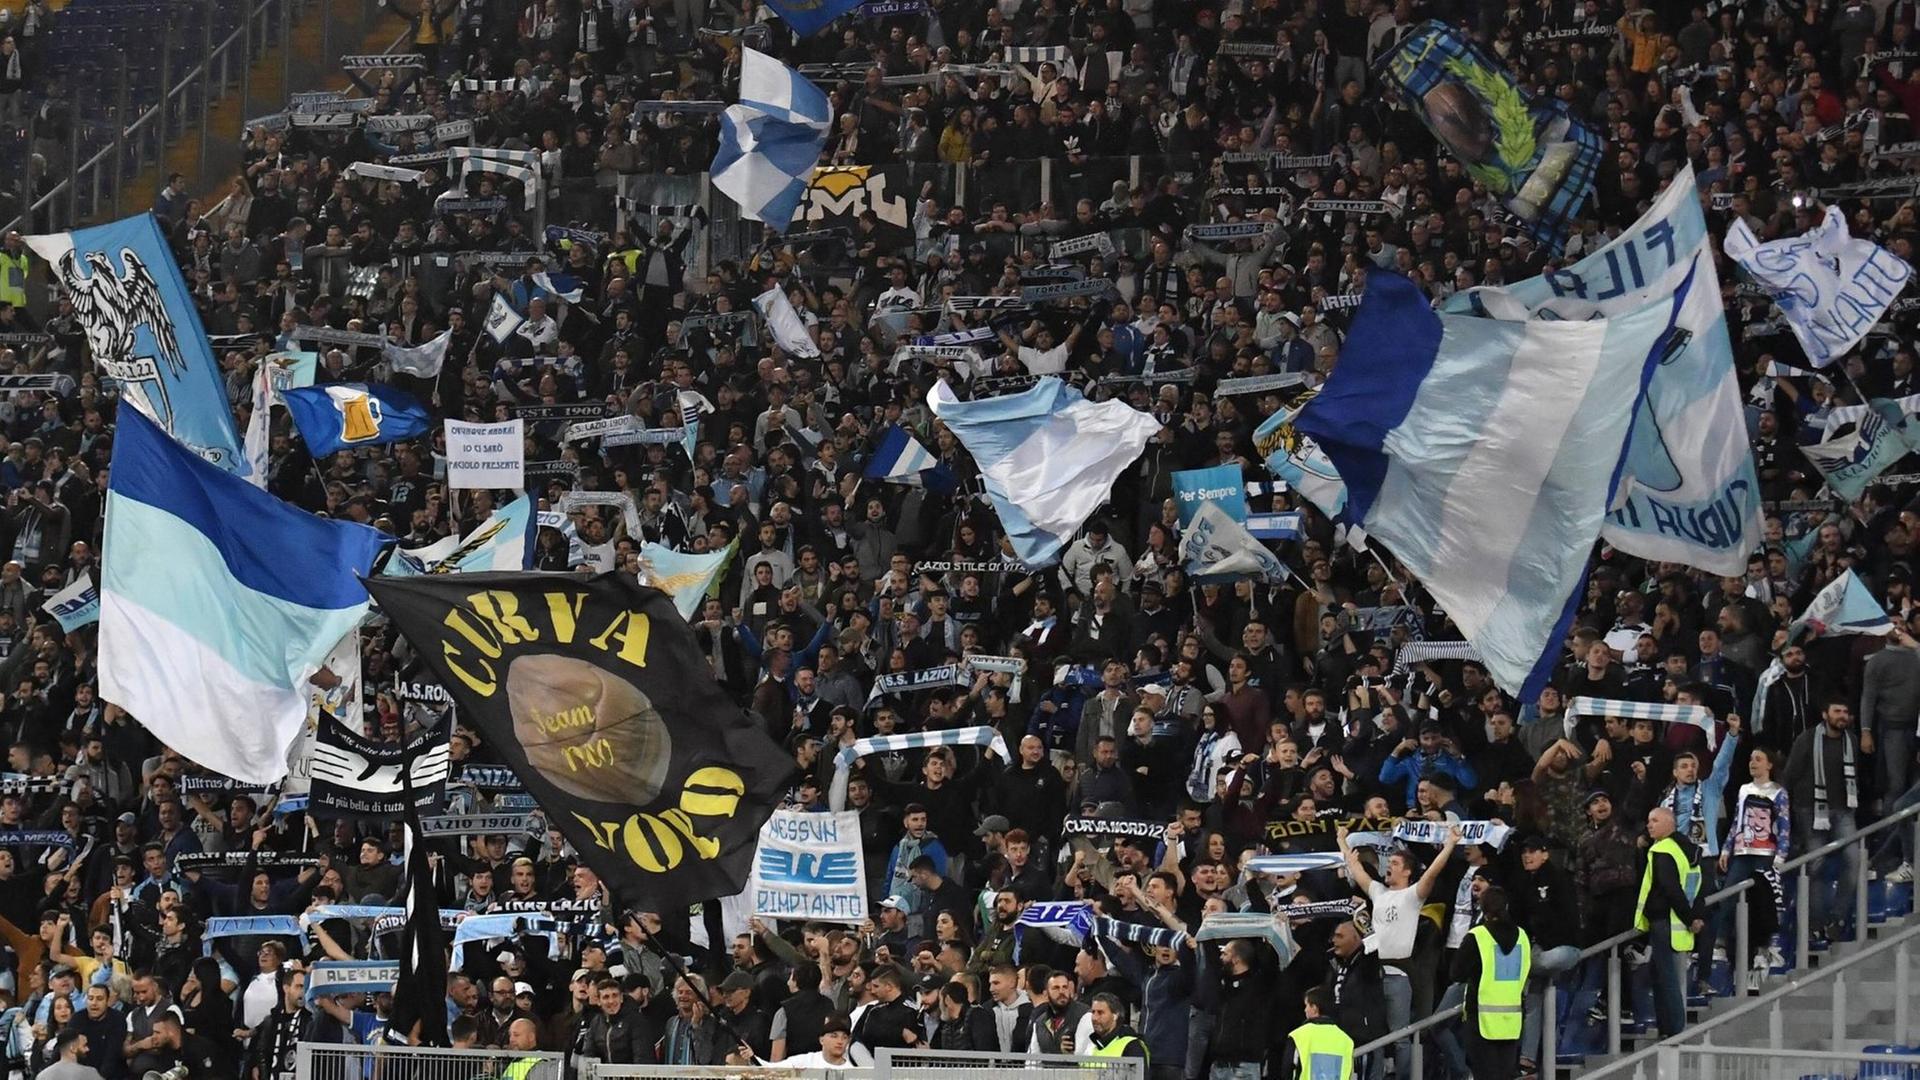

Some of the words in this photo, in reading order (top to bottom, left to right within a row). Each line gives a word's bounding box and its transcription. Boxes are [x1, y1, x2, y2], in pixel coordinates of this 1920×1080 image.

[934, 346, 963, 357] LAZIO
[515, 408, 553, 419] EST.
[564, 406, 602, 416] 1900
[1197, 485, 1237, 501] Sempre
[916, 560, 950, 572] LAZIO
[953, 561, 986, 572] STILE
[885, 674, 909, 688] S.S.
[913, 667, 952, 684] LAZIO
[349, 799, 370, 811] bella
[371, 801, 382, 812] di
[422, 818, 473, 832] LAZIO
[480, 817, 523, 829] 1900
[326, 969, 353, 982] ALE
